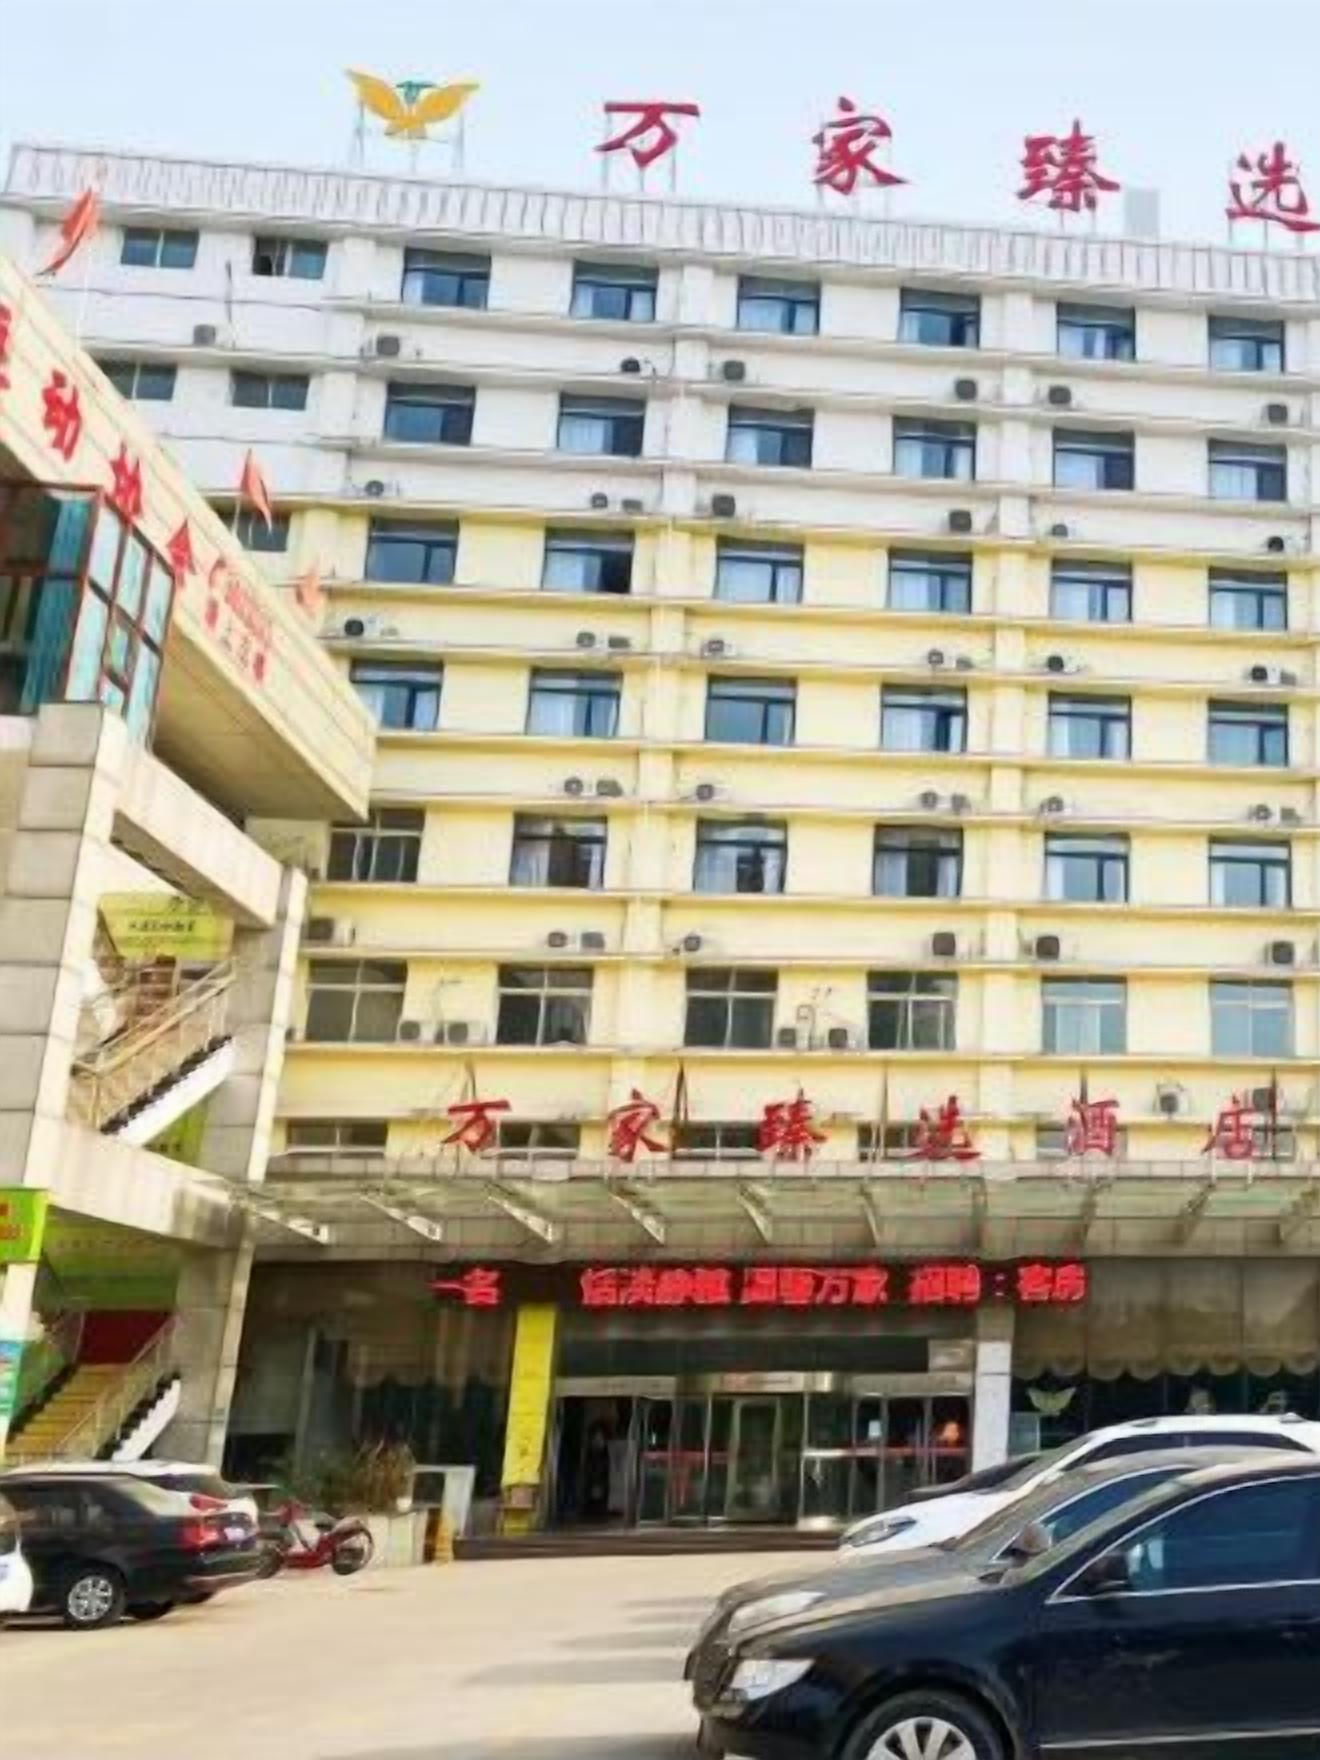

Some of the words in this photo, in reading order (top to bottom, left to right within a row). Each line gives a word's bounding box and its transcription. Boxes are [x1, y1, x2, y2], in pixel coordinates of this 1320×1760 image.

[442, 1088, 1255, 1163] 万家臻选酒店
